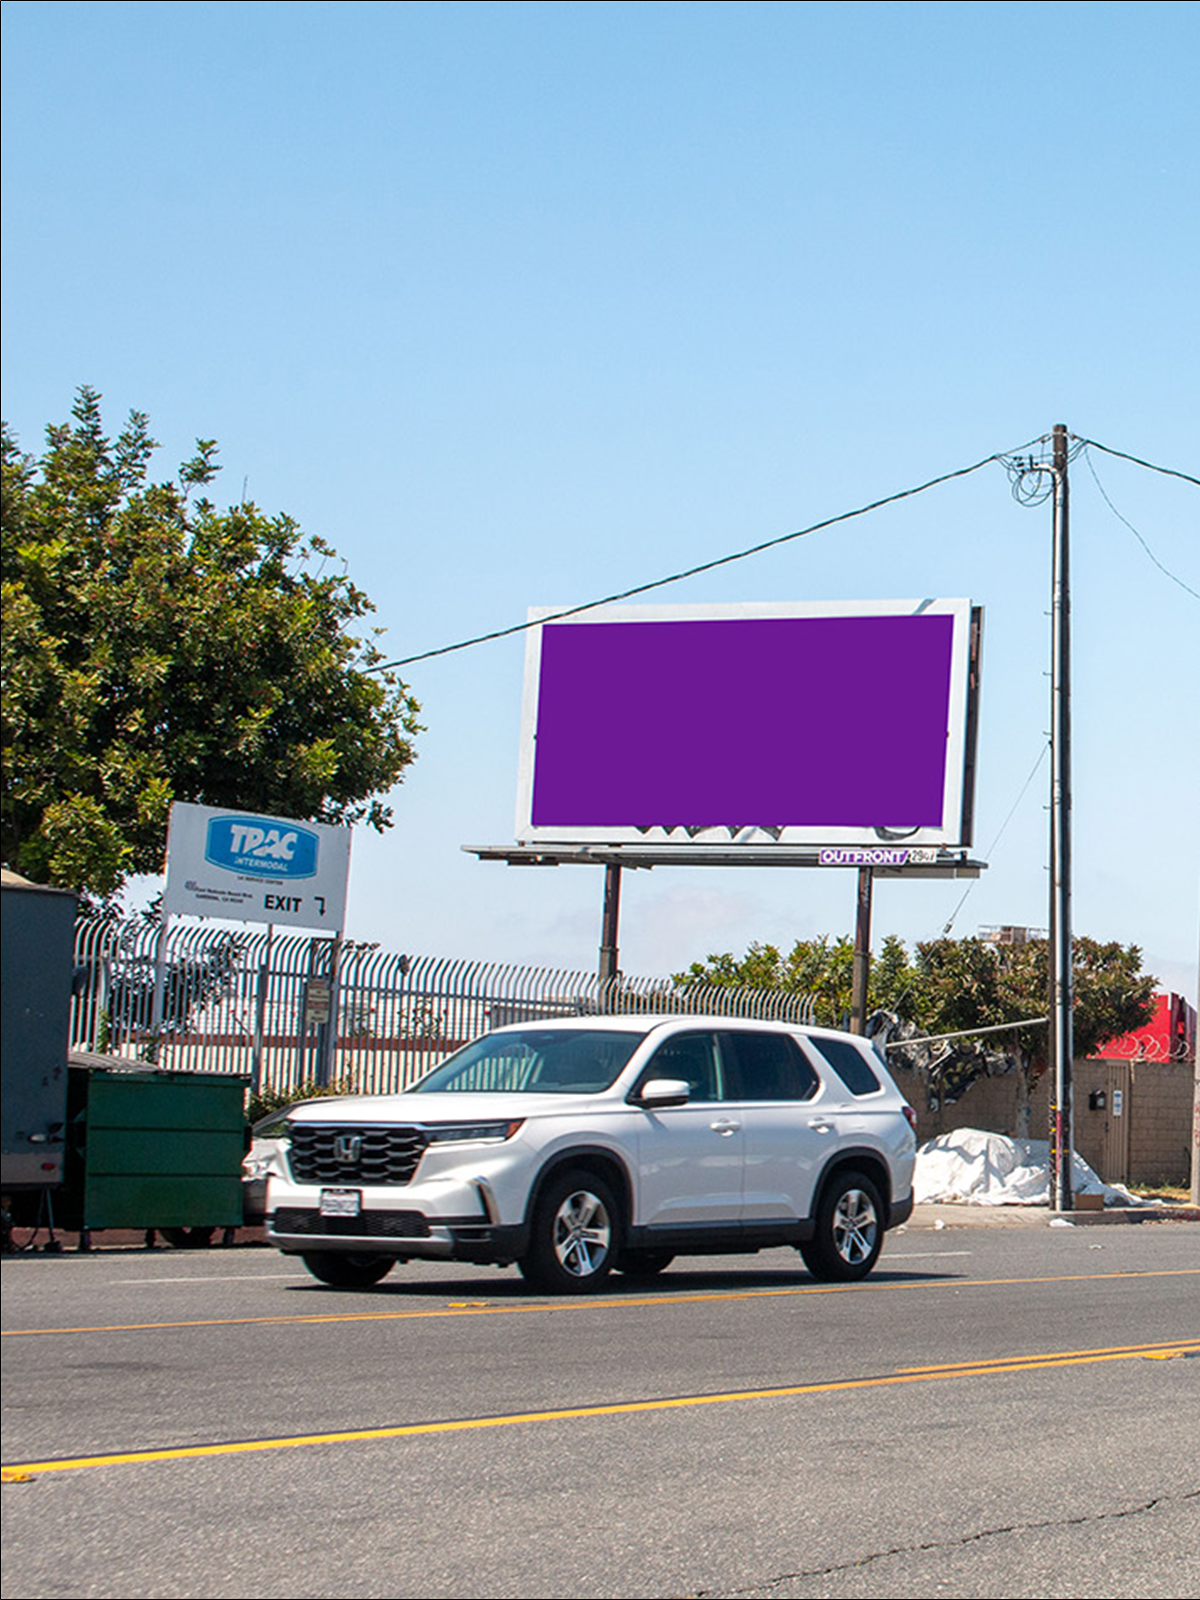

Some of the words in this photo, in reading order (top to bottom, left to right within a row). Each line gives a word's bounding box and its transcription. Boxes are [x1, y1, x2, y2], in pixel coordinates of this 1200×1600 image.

[822, 850, 902, 862] OUTFRONT
[235, 857, 288, 871] INTERMODAL
[264, 894, 302, 912] EXIT
